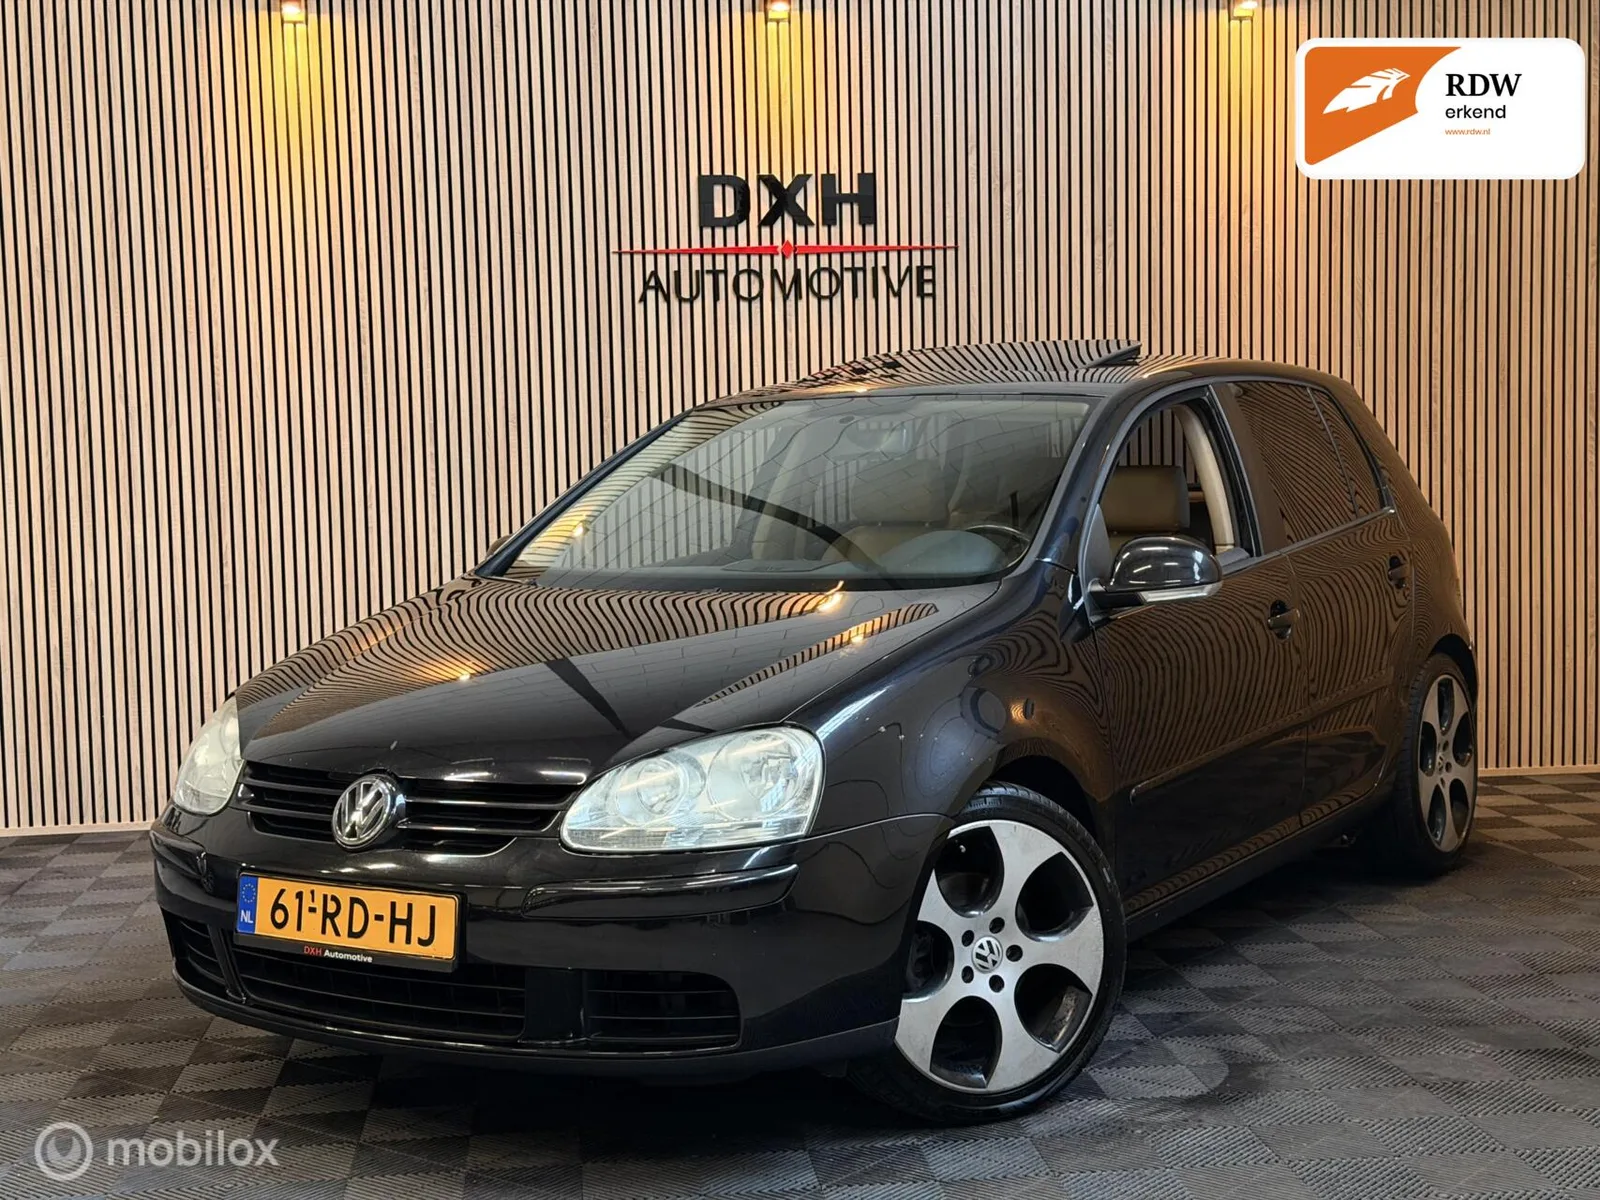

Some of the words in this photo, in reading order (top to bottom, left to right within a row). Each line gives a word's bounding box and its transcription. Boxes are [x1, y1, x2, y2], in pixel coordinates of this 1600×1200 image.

[698, 173, 876, 227] DXH
[639, 265, 936, 303] AUTOMOTIVE
[239, 909, 254, 924] NL
[303, 945, 323, 957] DXH
[324, 949, 374, 964] Automotive
